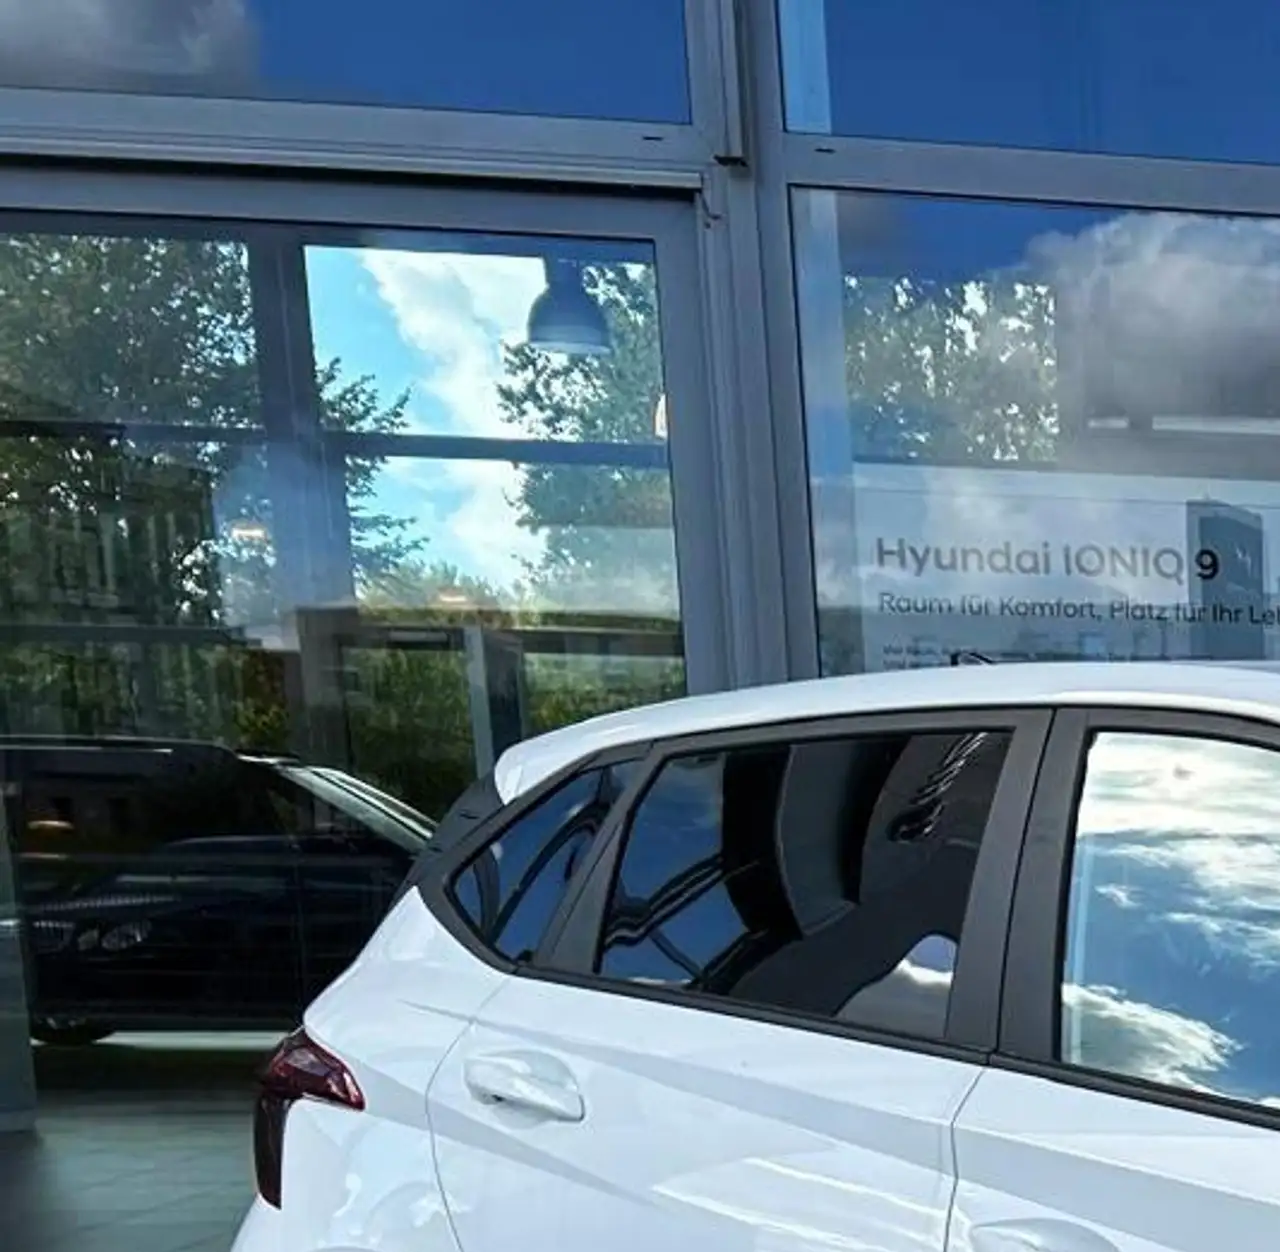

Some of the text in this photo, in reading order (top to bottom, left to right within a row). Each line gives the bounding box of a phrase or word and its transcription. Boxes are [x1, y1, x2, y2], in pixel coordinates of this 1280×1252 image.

[876, 537, 1220, 586] Hyundai IONIQ 9
[878, 592, 952, 615] Raum
[961, 594, 990, 615] für
[1000, 596, 1103, 622] Komfort,
[1110, 600, 1168, 622] Platz
[1212, 603, 1243, 624] Ihr
